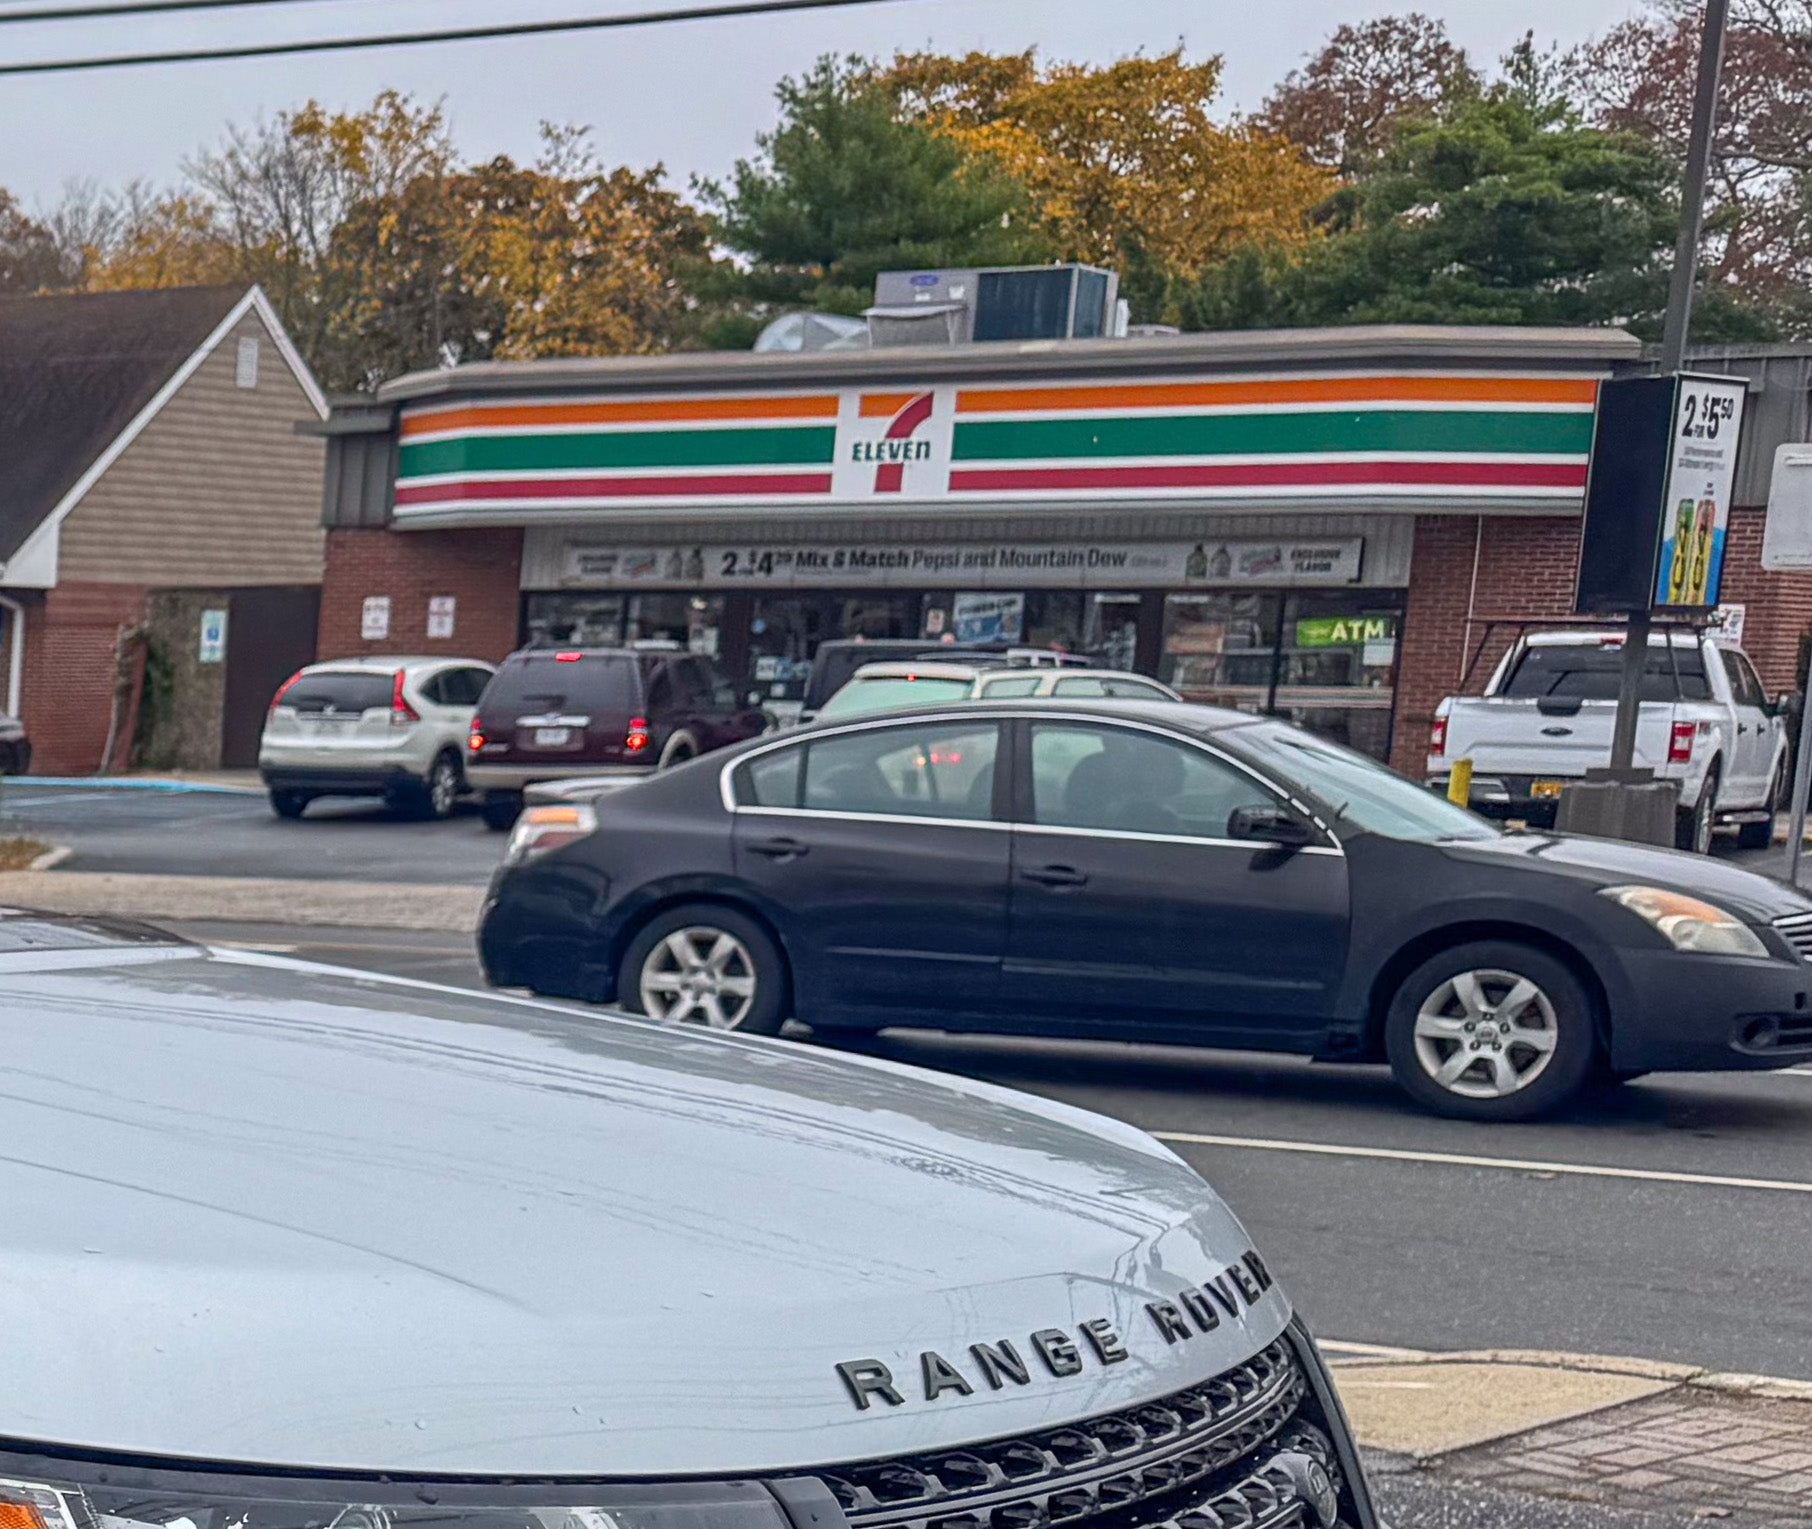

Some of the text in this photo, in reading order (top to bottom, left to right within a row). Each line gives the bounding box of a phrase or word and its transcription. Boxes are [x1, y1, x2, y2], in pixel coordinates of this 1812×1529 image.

[1681, 394, 1697, 437] 2
[858, 391, 934, 492] 7
[721, 550, 738, 576] 2
[796, 550, 829, 568] Mix
[850, 549, 910, 568] Match
[912, 549, 961, 572] Pepsi
[963, 549, 996, 568] and
[999, 549, 1085, 569] Mountain
[1087, 548, 1127, 568] Dew
[1331, 618, 1385, 642] ATM
[835, 1249, 1273, 1411] RANGE ROVER
